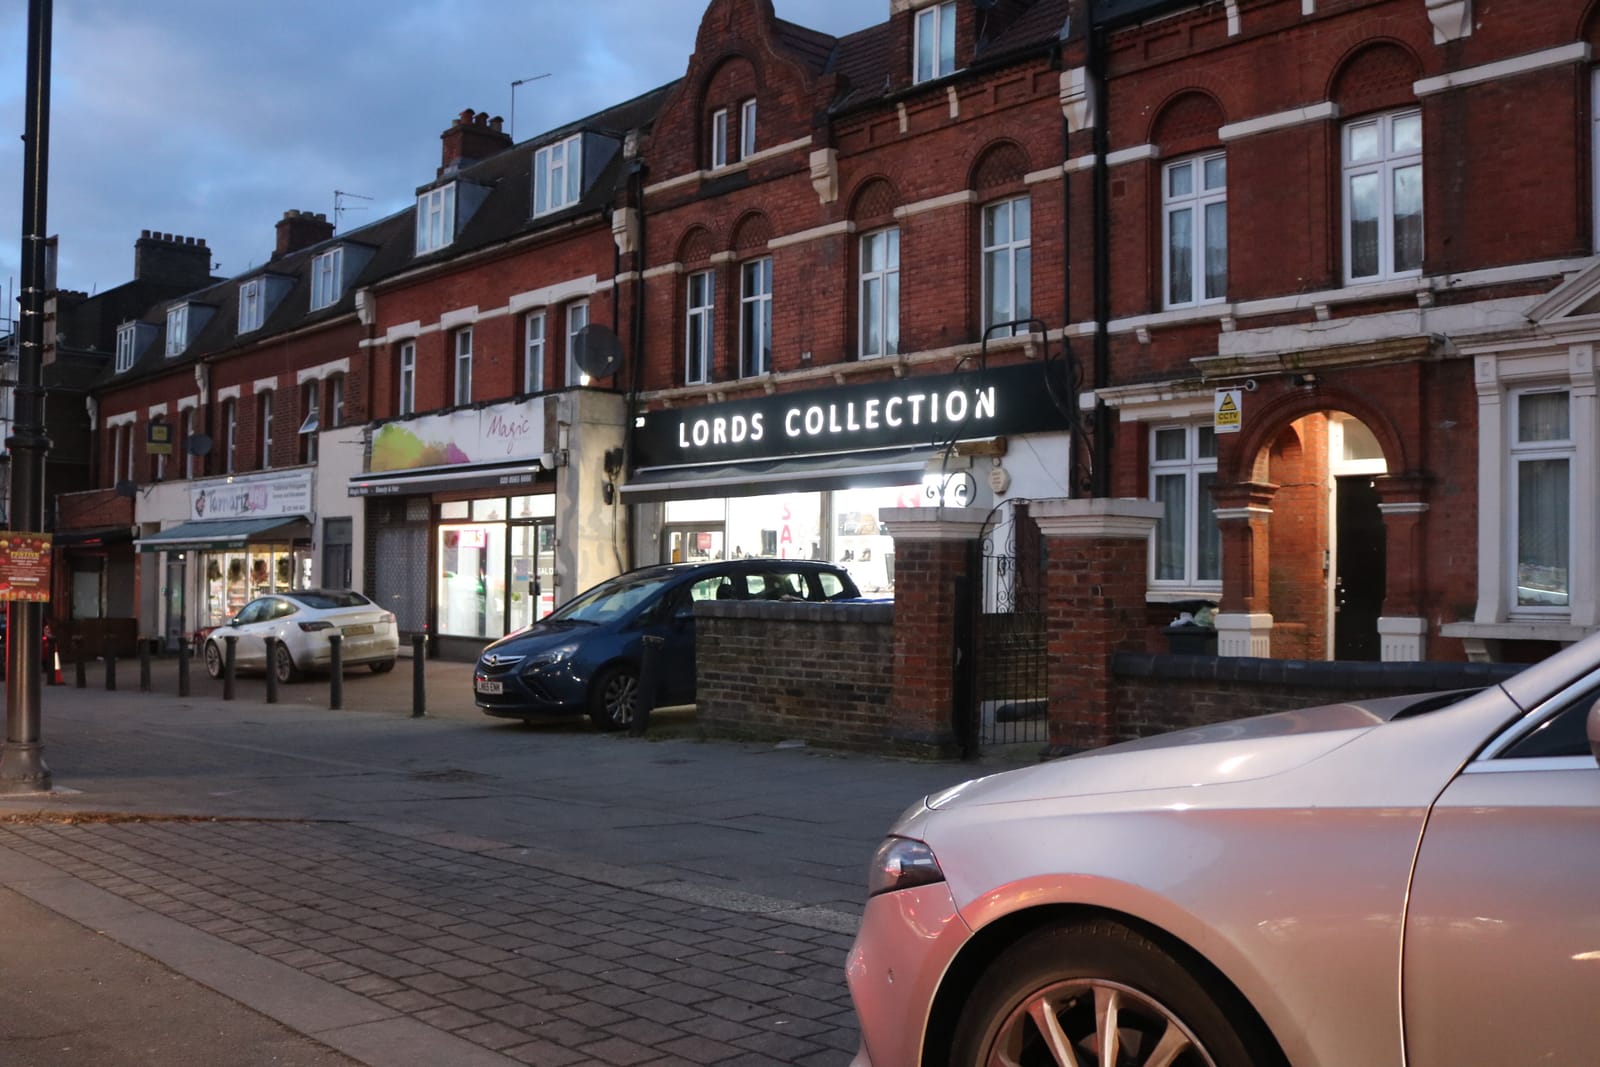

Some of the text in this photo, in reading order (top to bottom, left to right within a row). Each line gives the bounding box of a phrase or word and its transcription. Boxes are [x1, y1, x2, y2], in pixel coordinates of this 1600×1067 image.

[486, 414, 530, 455] Magic
[679, 386, 995, 448] LORDS COLLECTION
[1218, 411, 1239, 420] CCTV
